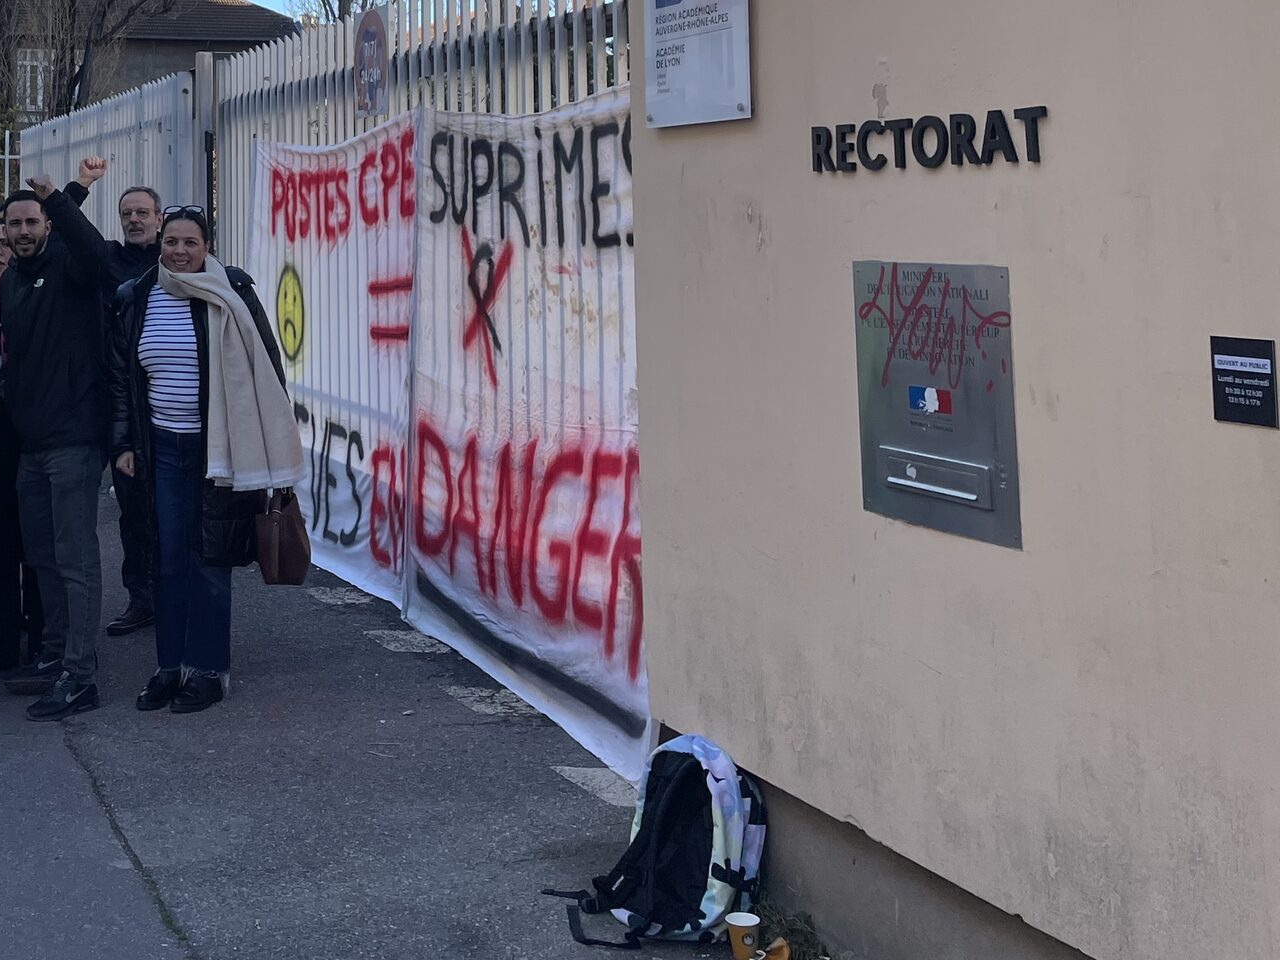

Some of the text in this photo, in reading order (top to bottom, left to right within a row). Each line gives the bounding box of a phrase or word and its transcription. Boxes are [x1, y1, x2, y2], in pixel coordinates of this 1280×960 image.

[655, 2, 718, 25] RÉGION ACADÉMIQUE
[655, 13, 729, 36] AUVERGNE-RHÔNE-ALPES
[655, 44, 685, 58] ACADÉMIE
[656, 57, 681, 69] DE LYON
[811, 105, 1048, 174] RECTORAT
[270, 165, 352, 244] POSTES
[358, 126, 415, 226] CPE
[1248, 362, 1268, 370] PUBLIC
